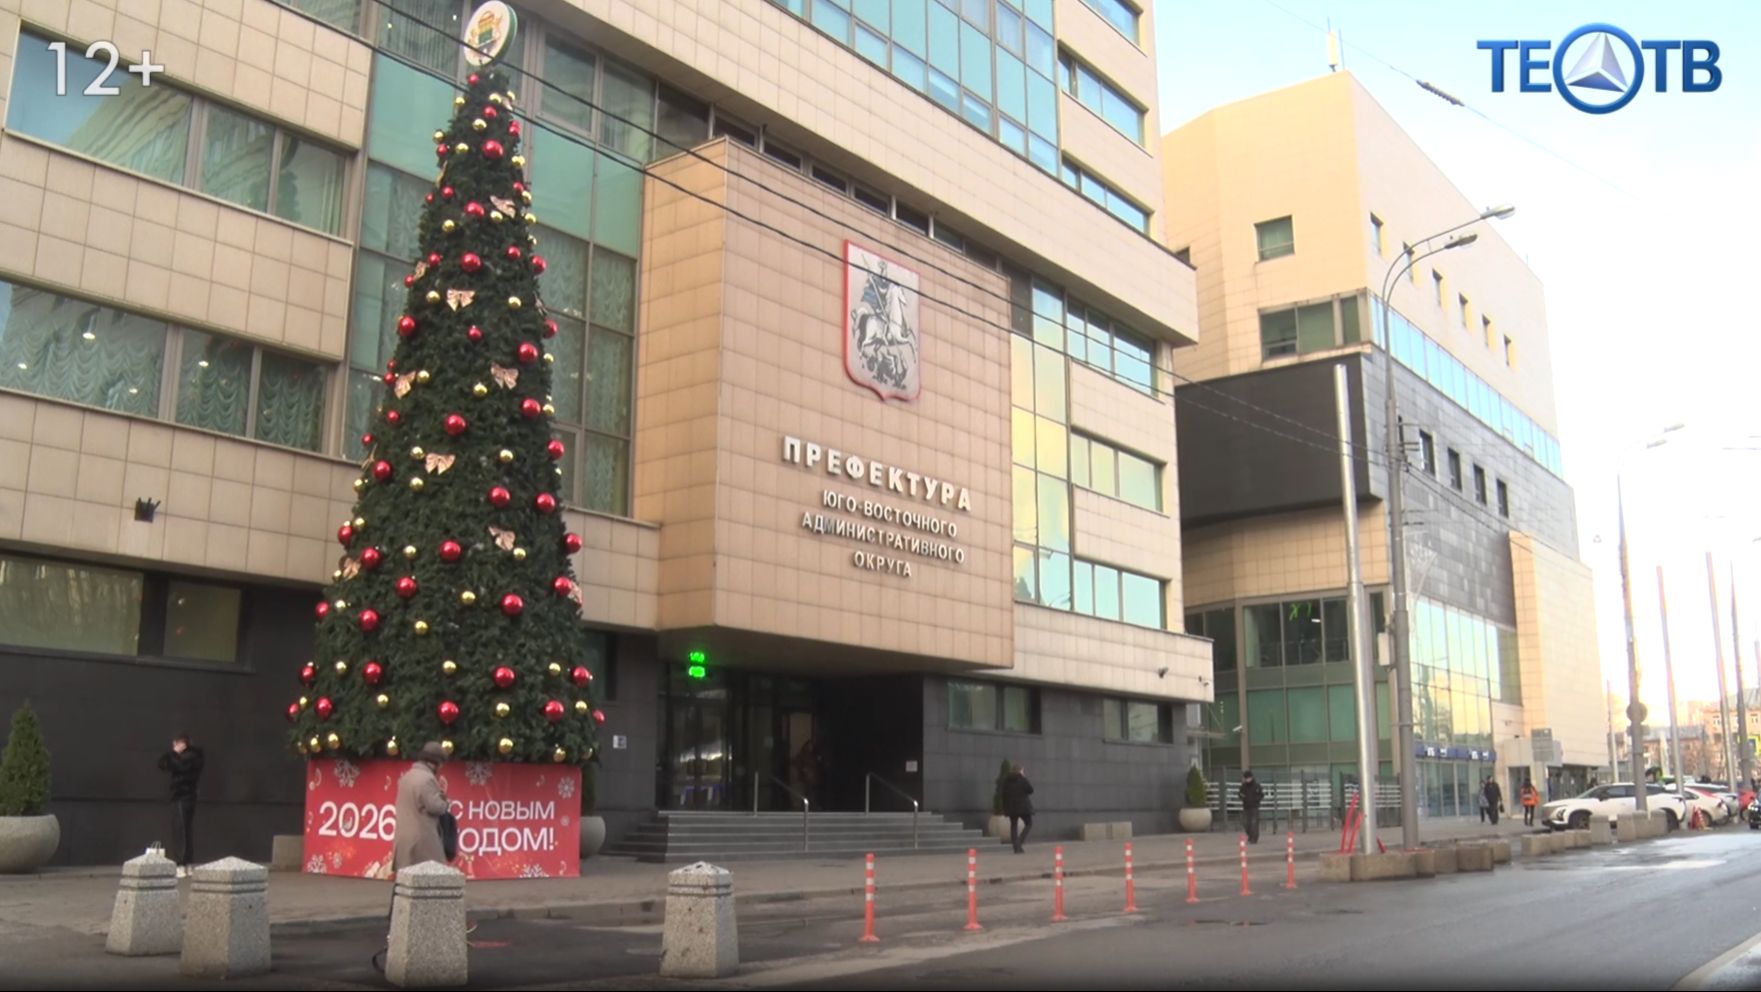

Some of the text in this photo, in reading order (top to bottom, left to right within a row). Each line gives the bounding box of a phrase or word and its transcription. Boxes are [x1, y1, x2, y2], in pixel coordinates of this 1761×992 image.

[783, 435, 971, 511] ПРЕФЕКТУРА
[823, 489, 957, 537] ЮГО-ВОСТОЧНОГО
[802, 511, 965, 563] АДМИНИСТРАТИВНОГО
[854, 550, 912, 577] ОКРУГА
[318, 801, 397, 841] 2026
[468, 800, 556, 821] НОВЫМ
[457, 828, 555, 856] ОДОМ!
